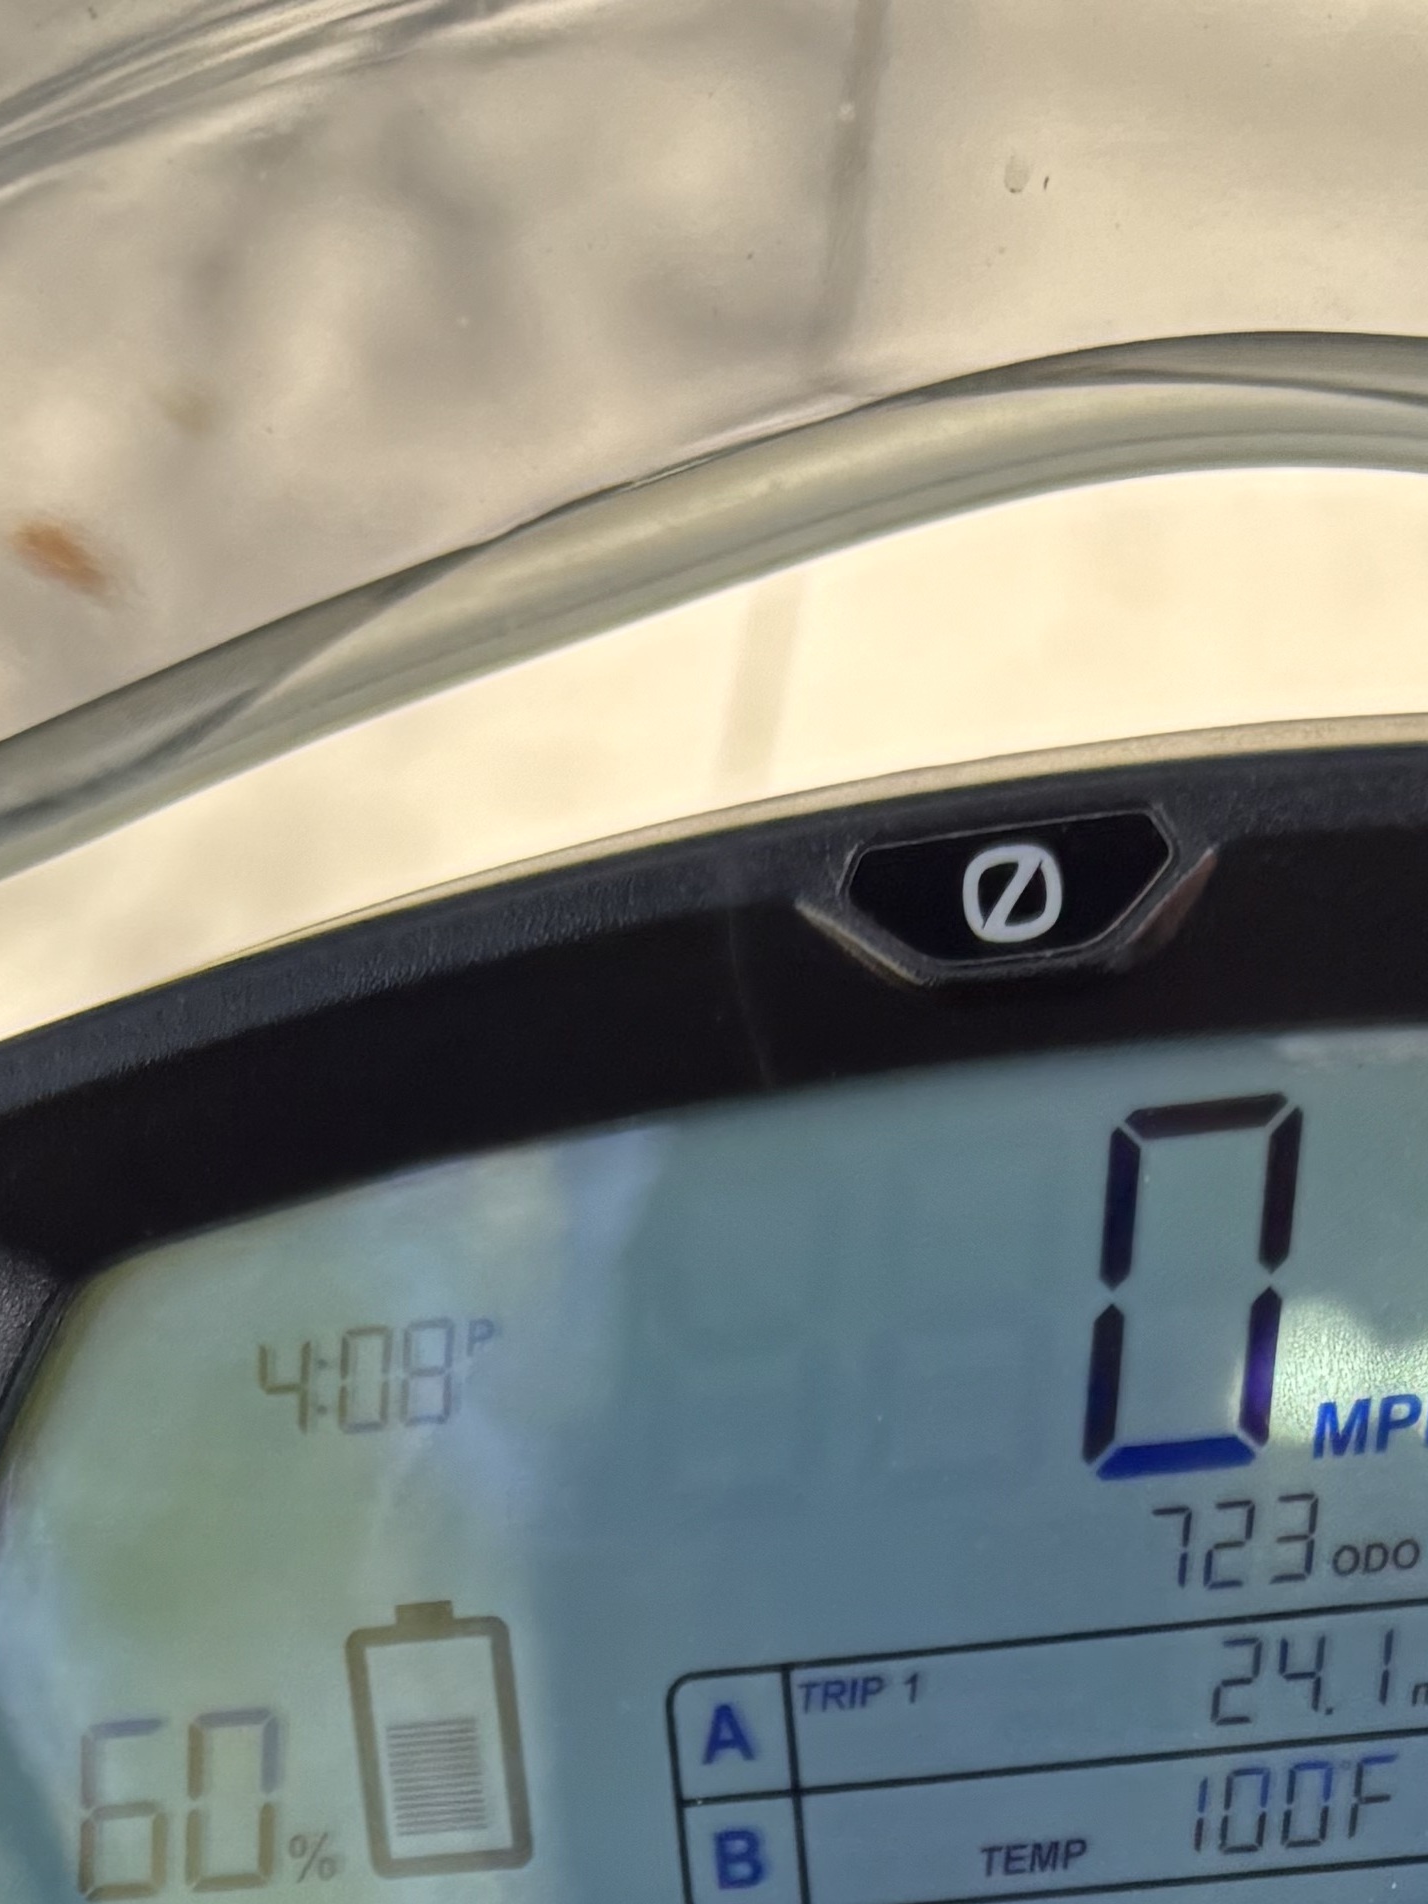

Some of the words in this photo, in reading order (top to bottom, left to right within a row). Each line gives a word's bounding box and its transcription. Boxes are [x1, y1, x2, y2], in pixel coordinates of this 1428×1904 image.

[1081, 1092, 1304, 1481] 0
[1151, 1492, 1320, 1591] 723
[1331, 1538, 1421, 1577] ODO
[798, 1676, 884, 1716] TRIP
[903, 1673, 923, 1705] 1
[1209, 1626, 1397, 1727] 24.1
[701, 1703, 756, 1767] A
[713, 1828, 767, 1892] B
[980, 1838, 1089, 1878] TEMP
